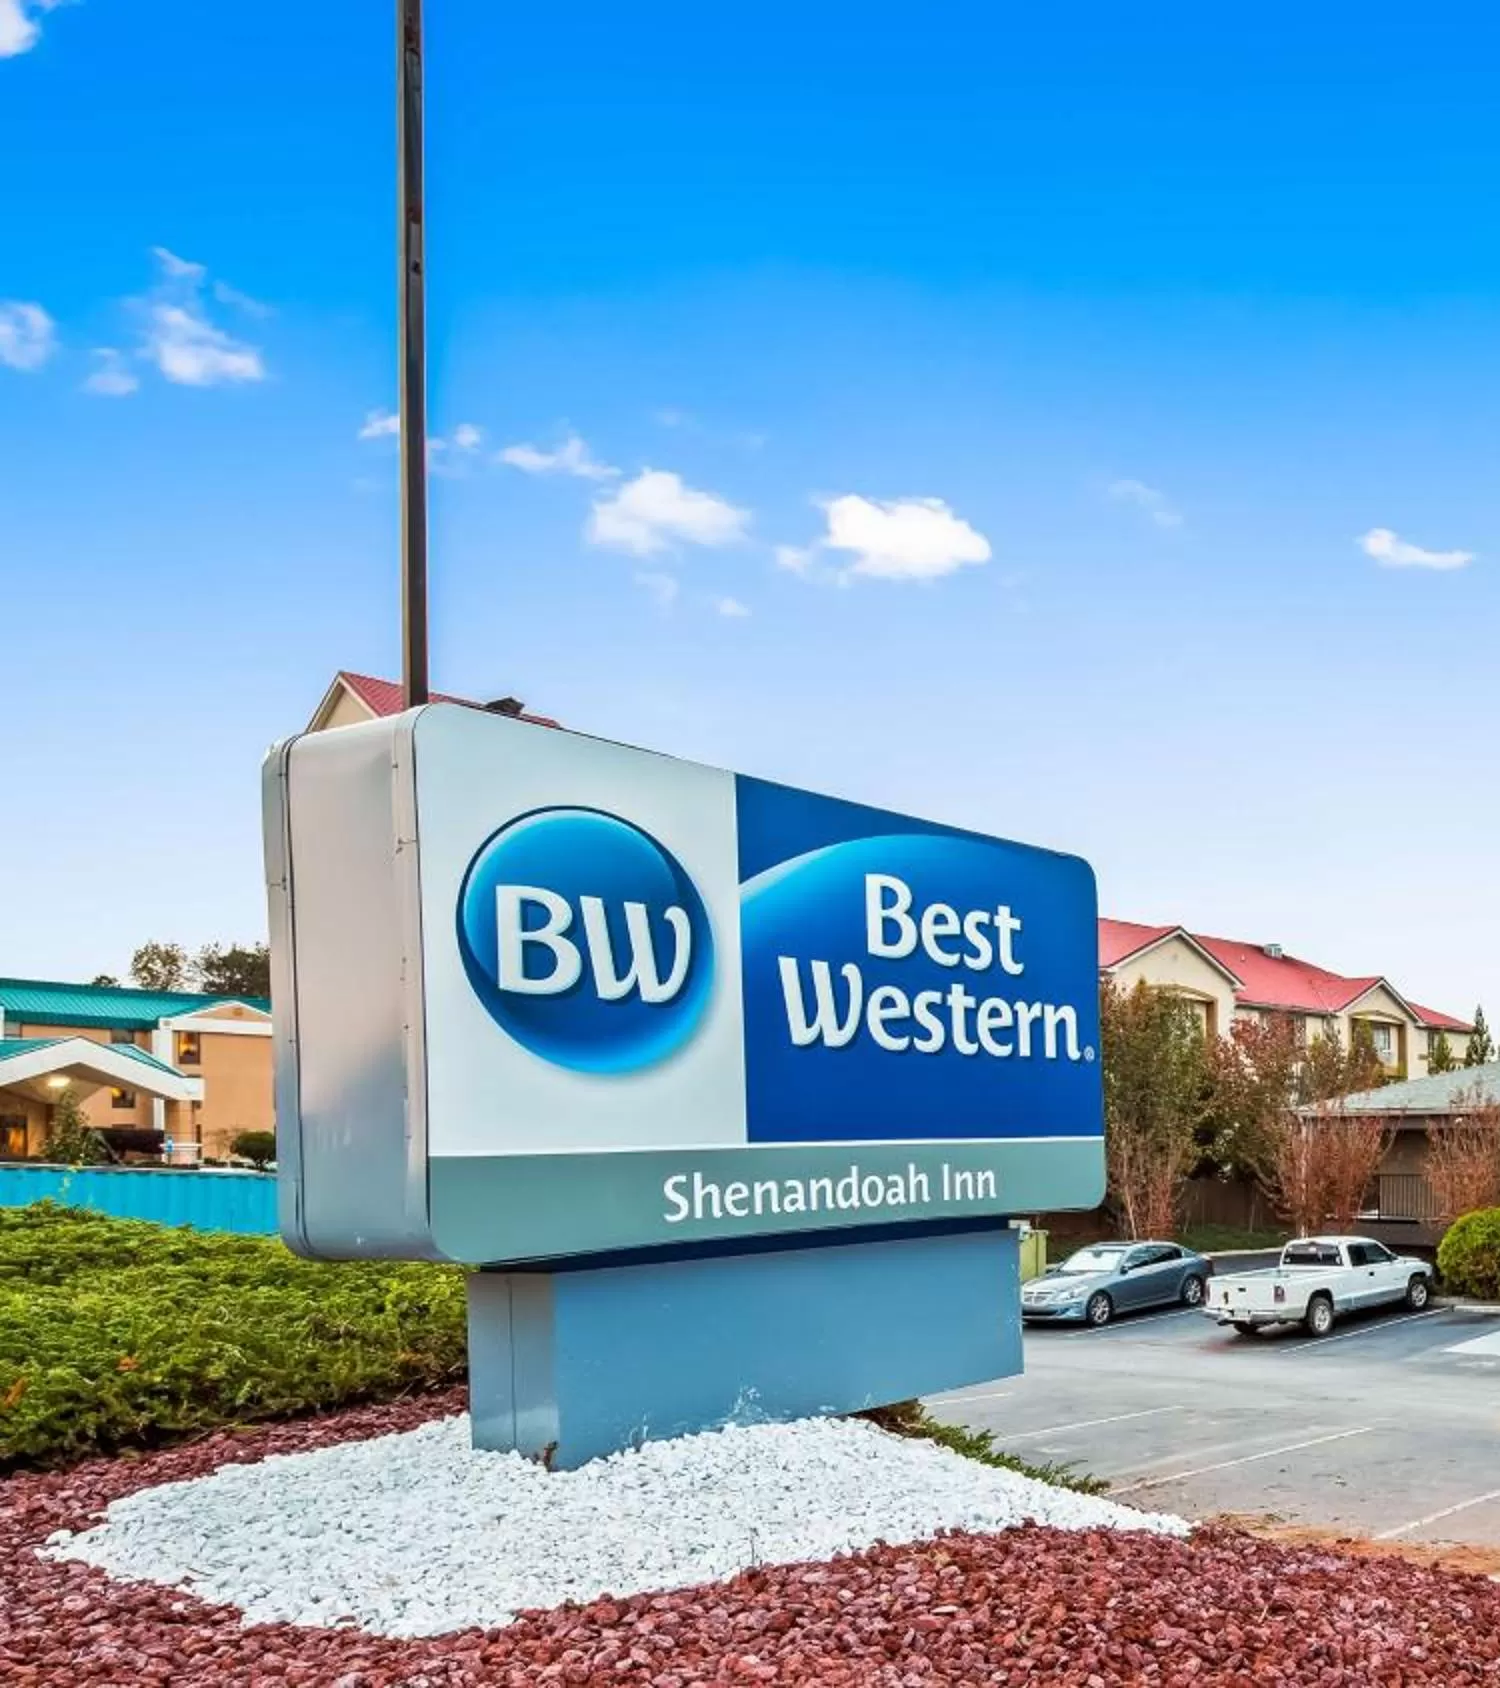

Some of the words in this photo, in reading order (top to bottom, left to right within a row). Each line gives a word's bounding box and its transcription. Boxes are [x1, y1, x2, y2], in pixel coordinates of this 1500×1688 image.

[496, 884, 692, 1003] BW
[864, 873, 1025, 976] Best
[662, 1162, 931, 1223] Shenandoah
[941, 1163, 998, 1202] Inn
